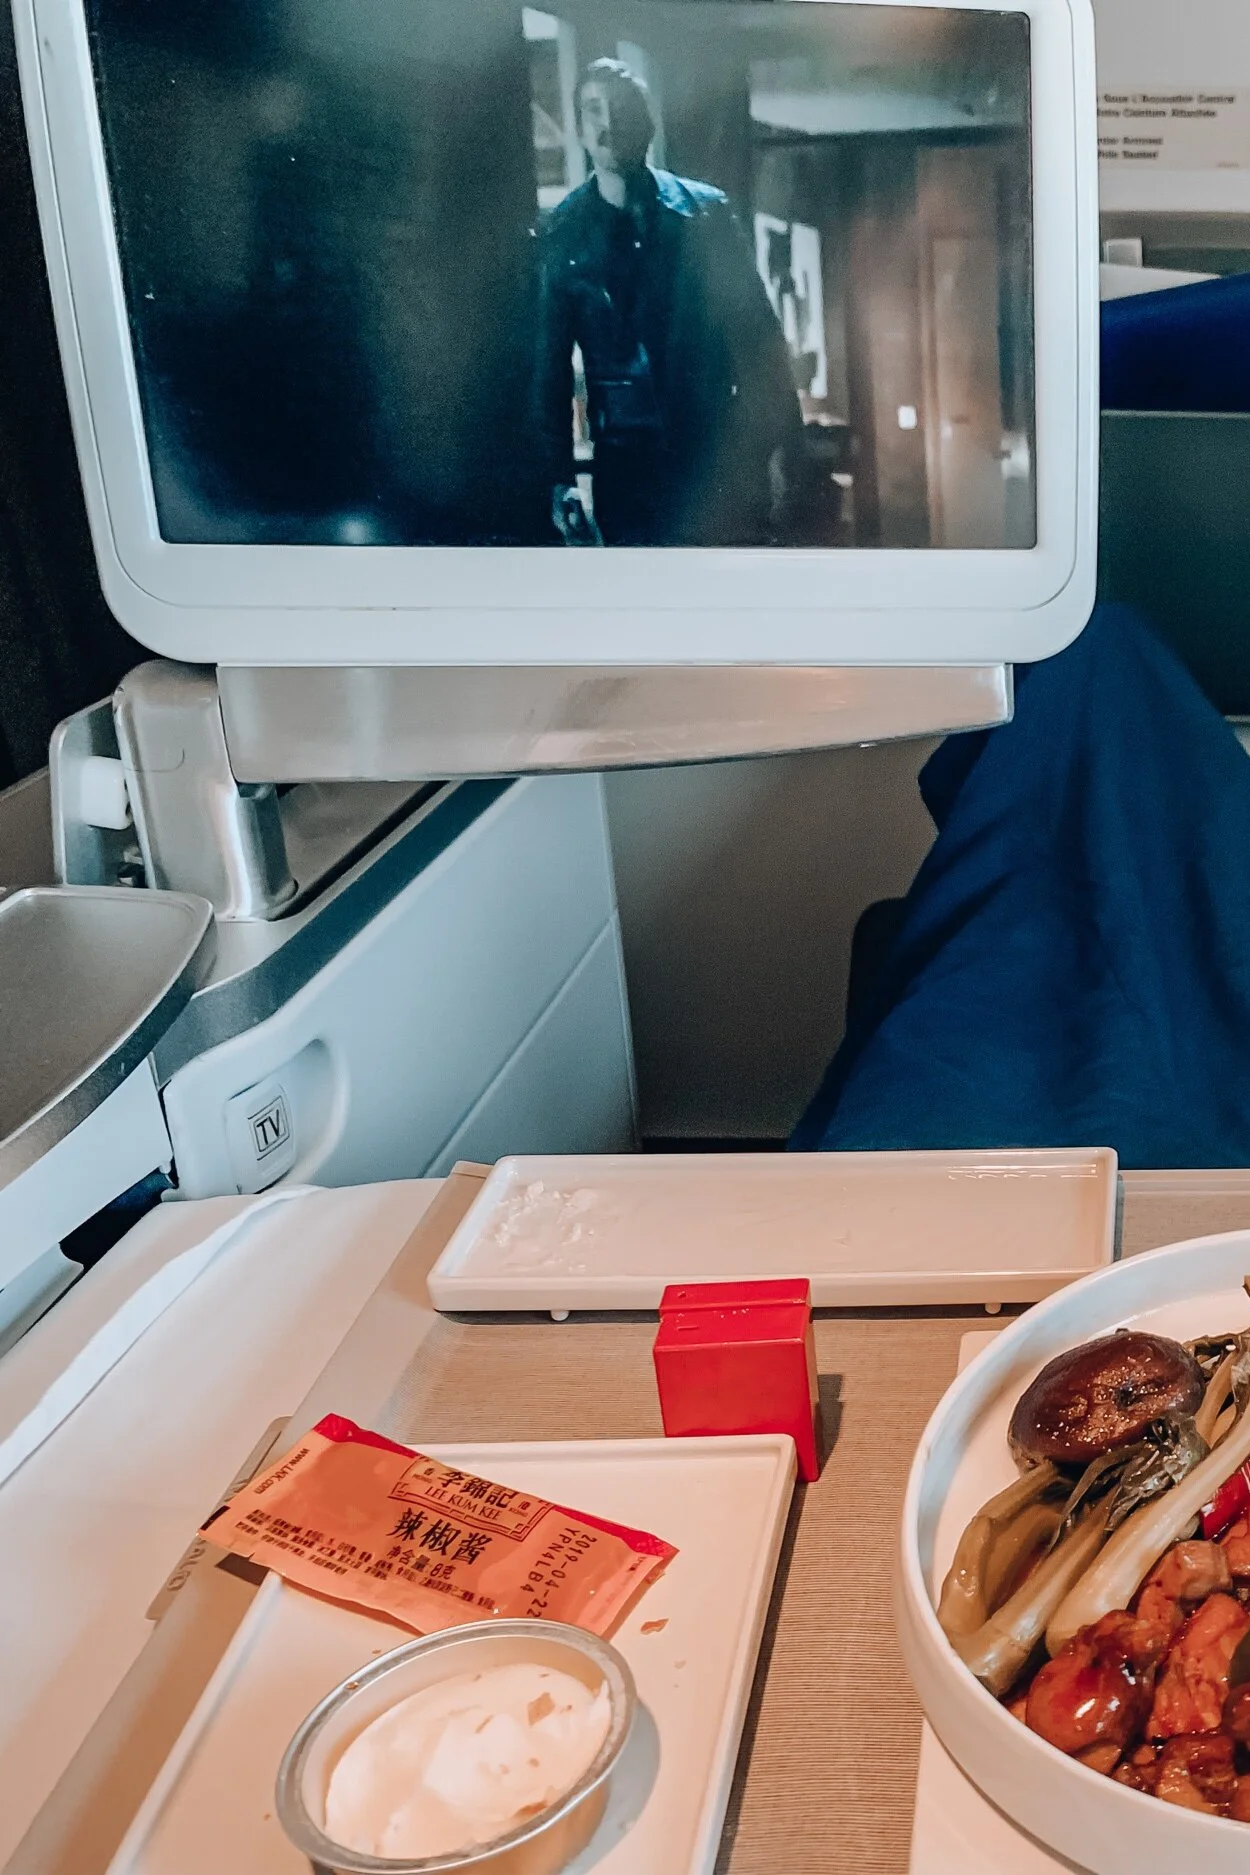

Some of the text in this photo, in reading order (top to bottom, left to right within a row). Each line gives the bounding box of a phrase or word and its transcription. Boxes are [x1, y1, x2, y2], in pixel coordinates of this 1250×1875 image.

[256, 1109, 280, 1146] TV
[424, 1486, 504, 1521] LEE KUM KEE
[386, 1507, 493, 1566] 辣椒酱
[520, 1527, 580, 1593] YPN4LB4
[526, 1533, 598, 1618] 2019-04-22
